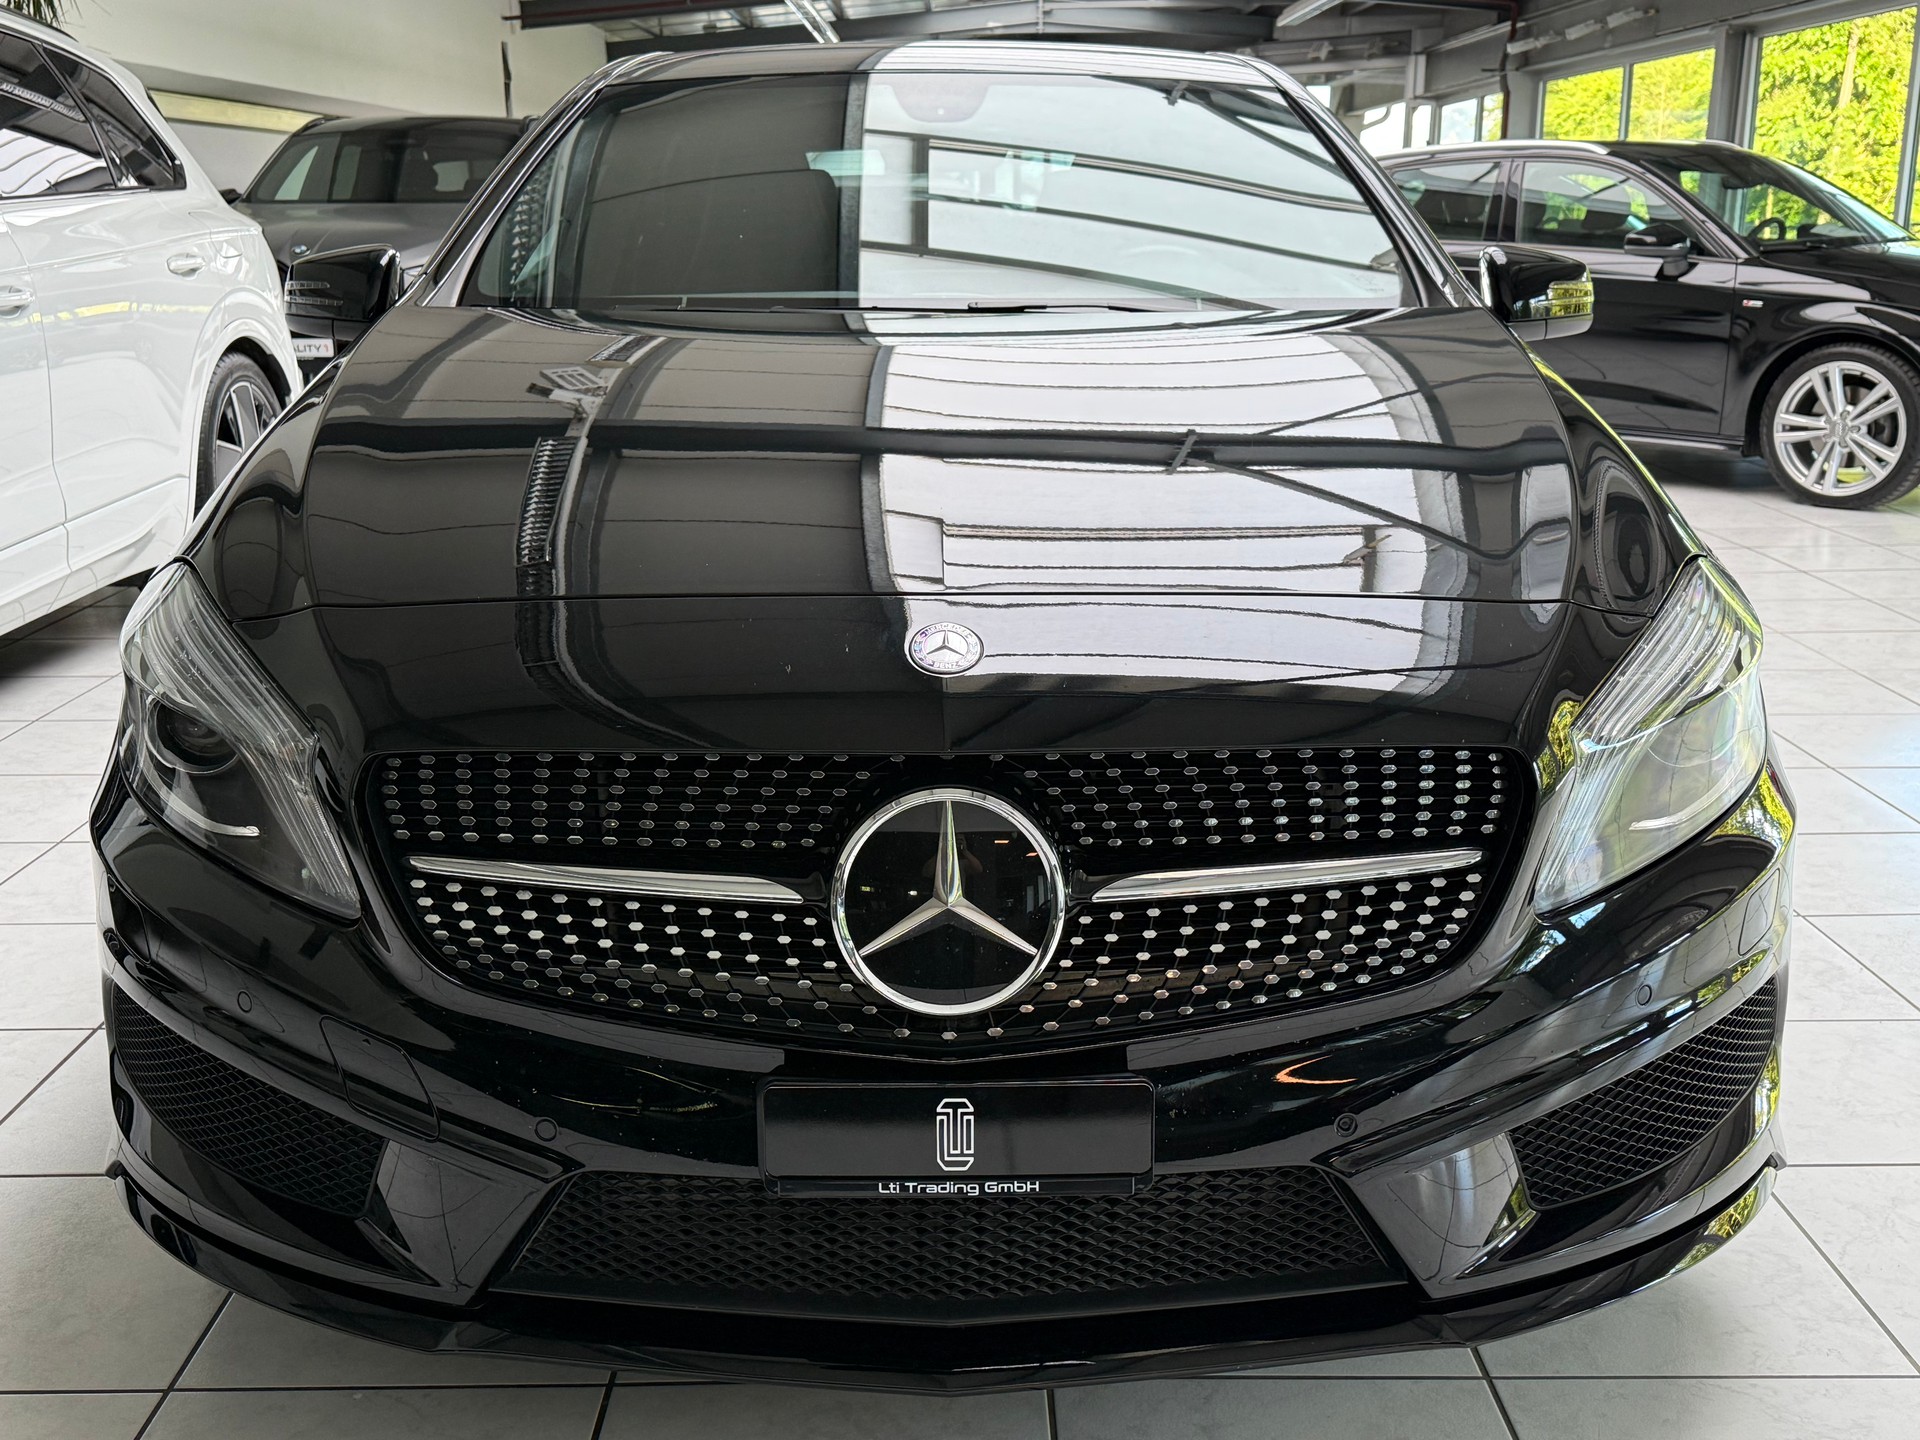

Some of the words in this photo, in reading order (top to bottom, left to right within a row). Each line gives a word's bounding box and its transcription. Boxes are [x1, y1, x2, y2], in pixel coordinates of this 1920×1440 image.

[293, 343, 322, 353] LITY
[878, 1181, 900, 1194] Lti
[904, 1181, 980, 1197] Trading
[984, 1180, 1040, 1194] GmbH
